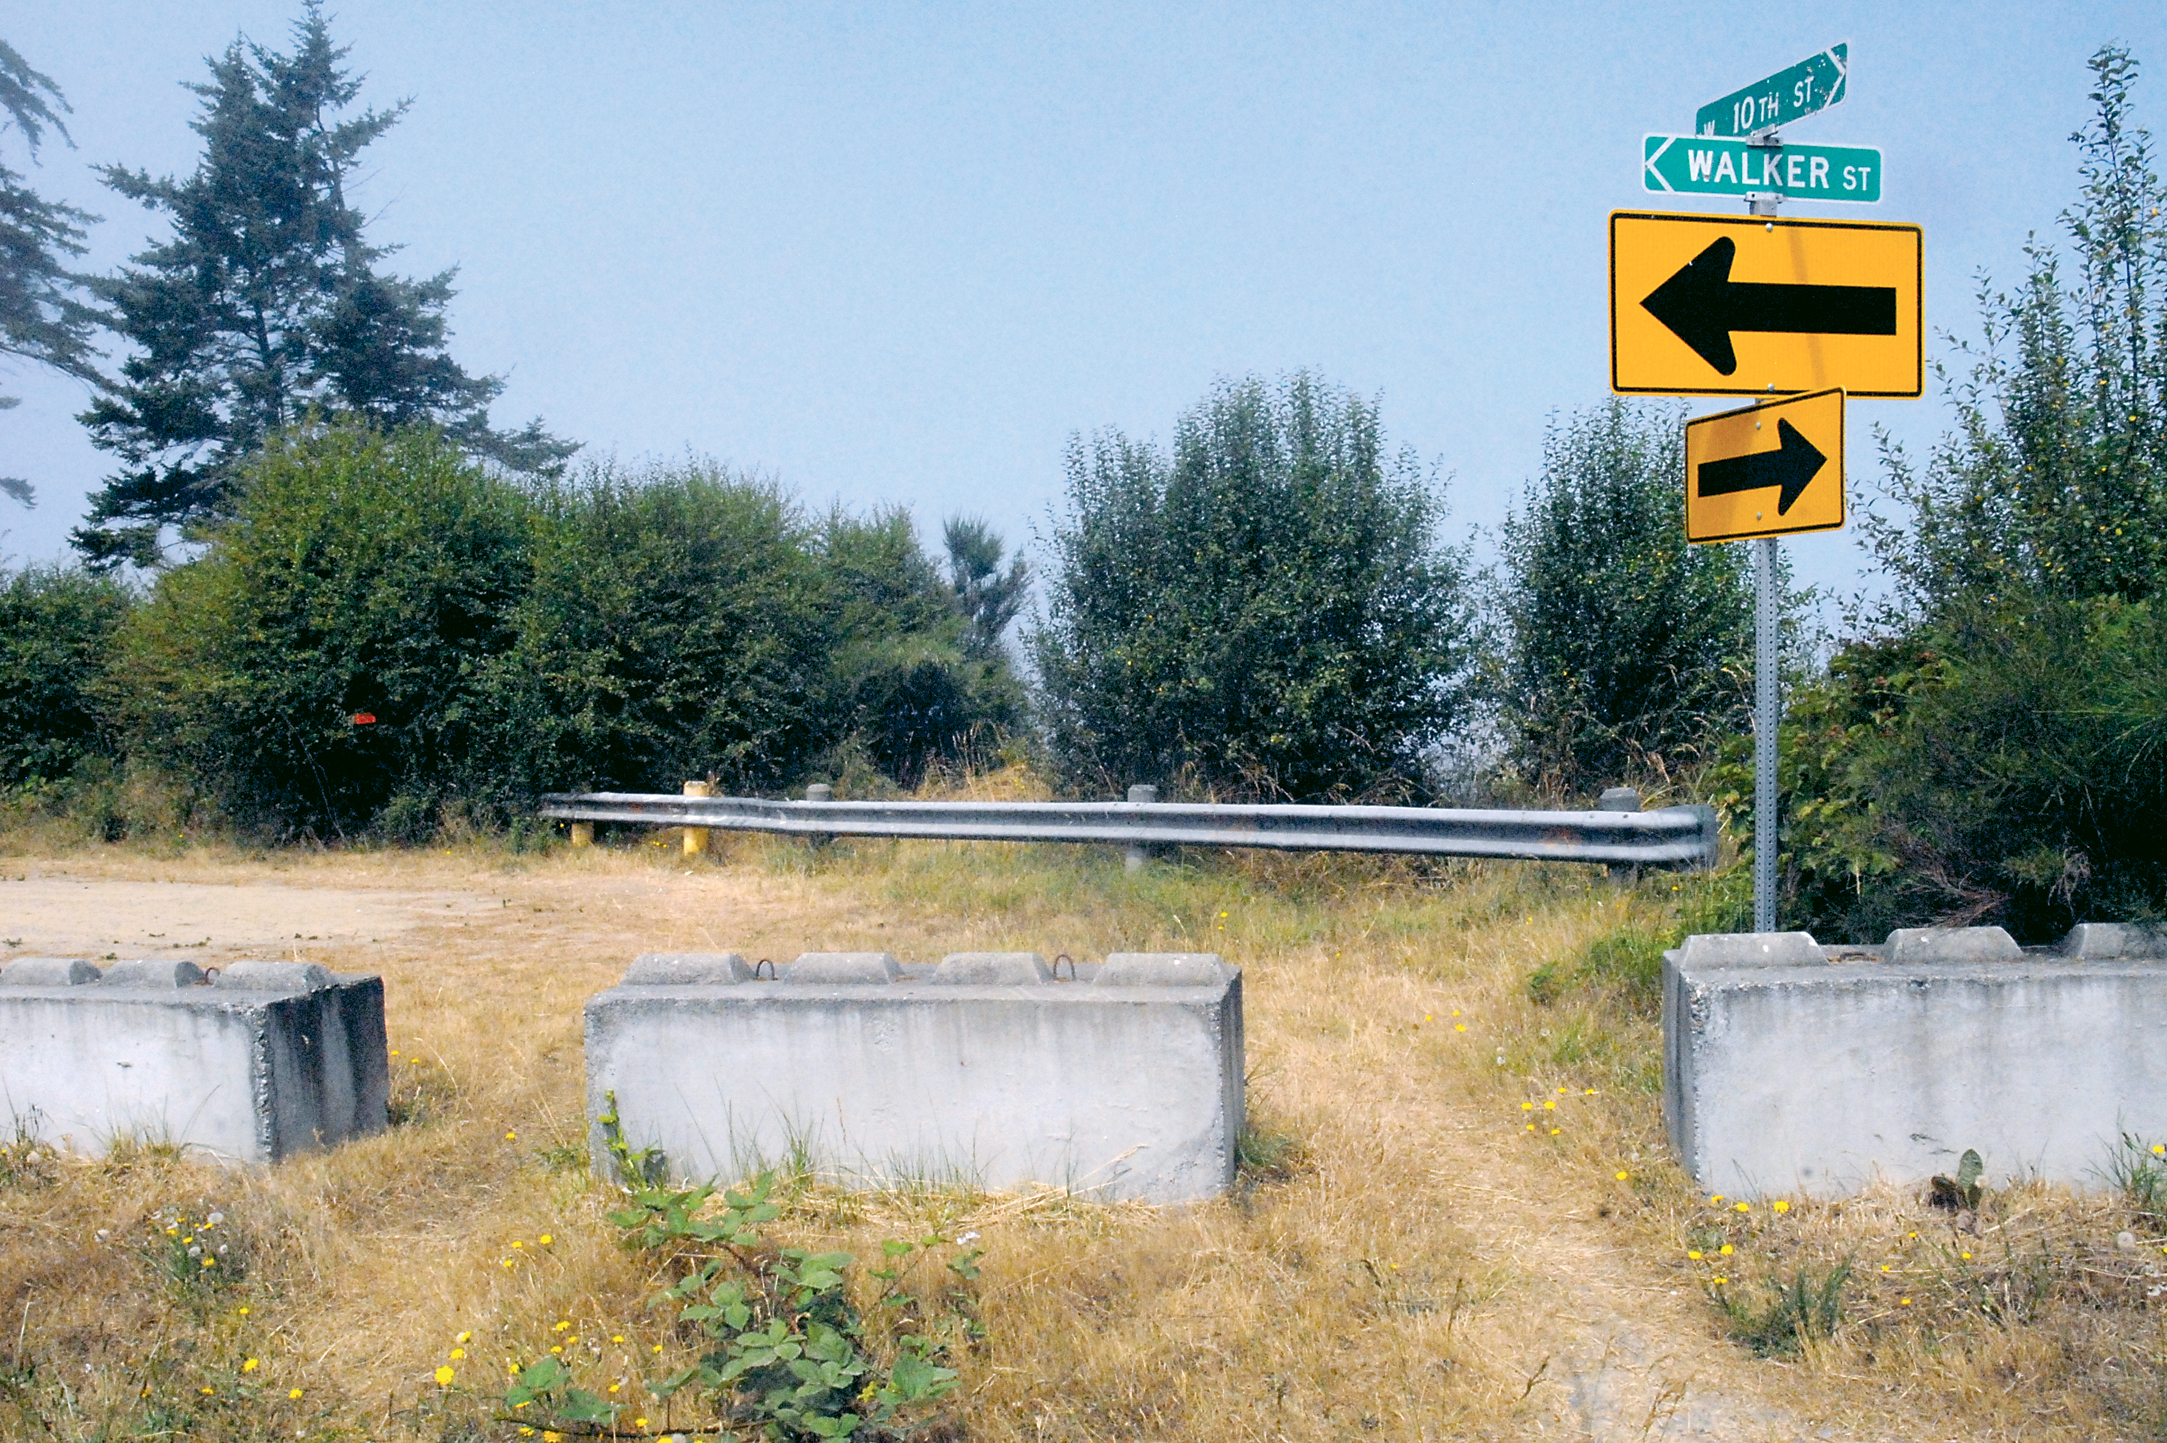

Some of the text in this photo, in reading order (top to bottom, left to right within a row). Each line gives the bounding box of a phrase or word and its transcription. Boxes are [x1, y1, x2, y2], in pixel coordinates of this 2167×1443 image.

[1733, 92, 1780, 134] 10TH
[1793, 76, 1815, 108] ST
[1687, 149, 1872, 191] WALKER ST
